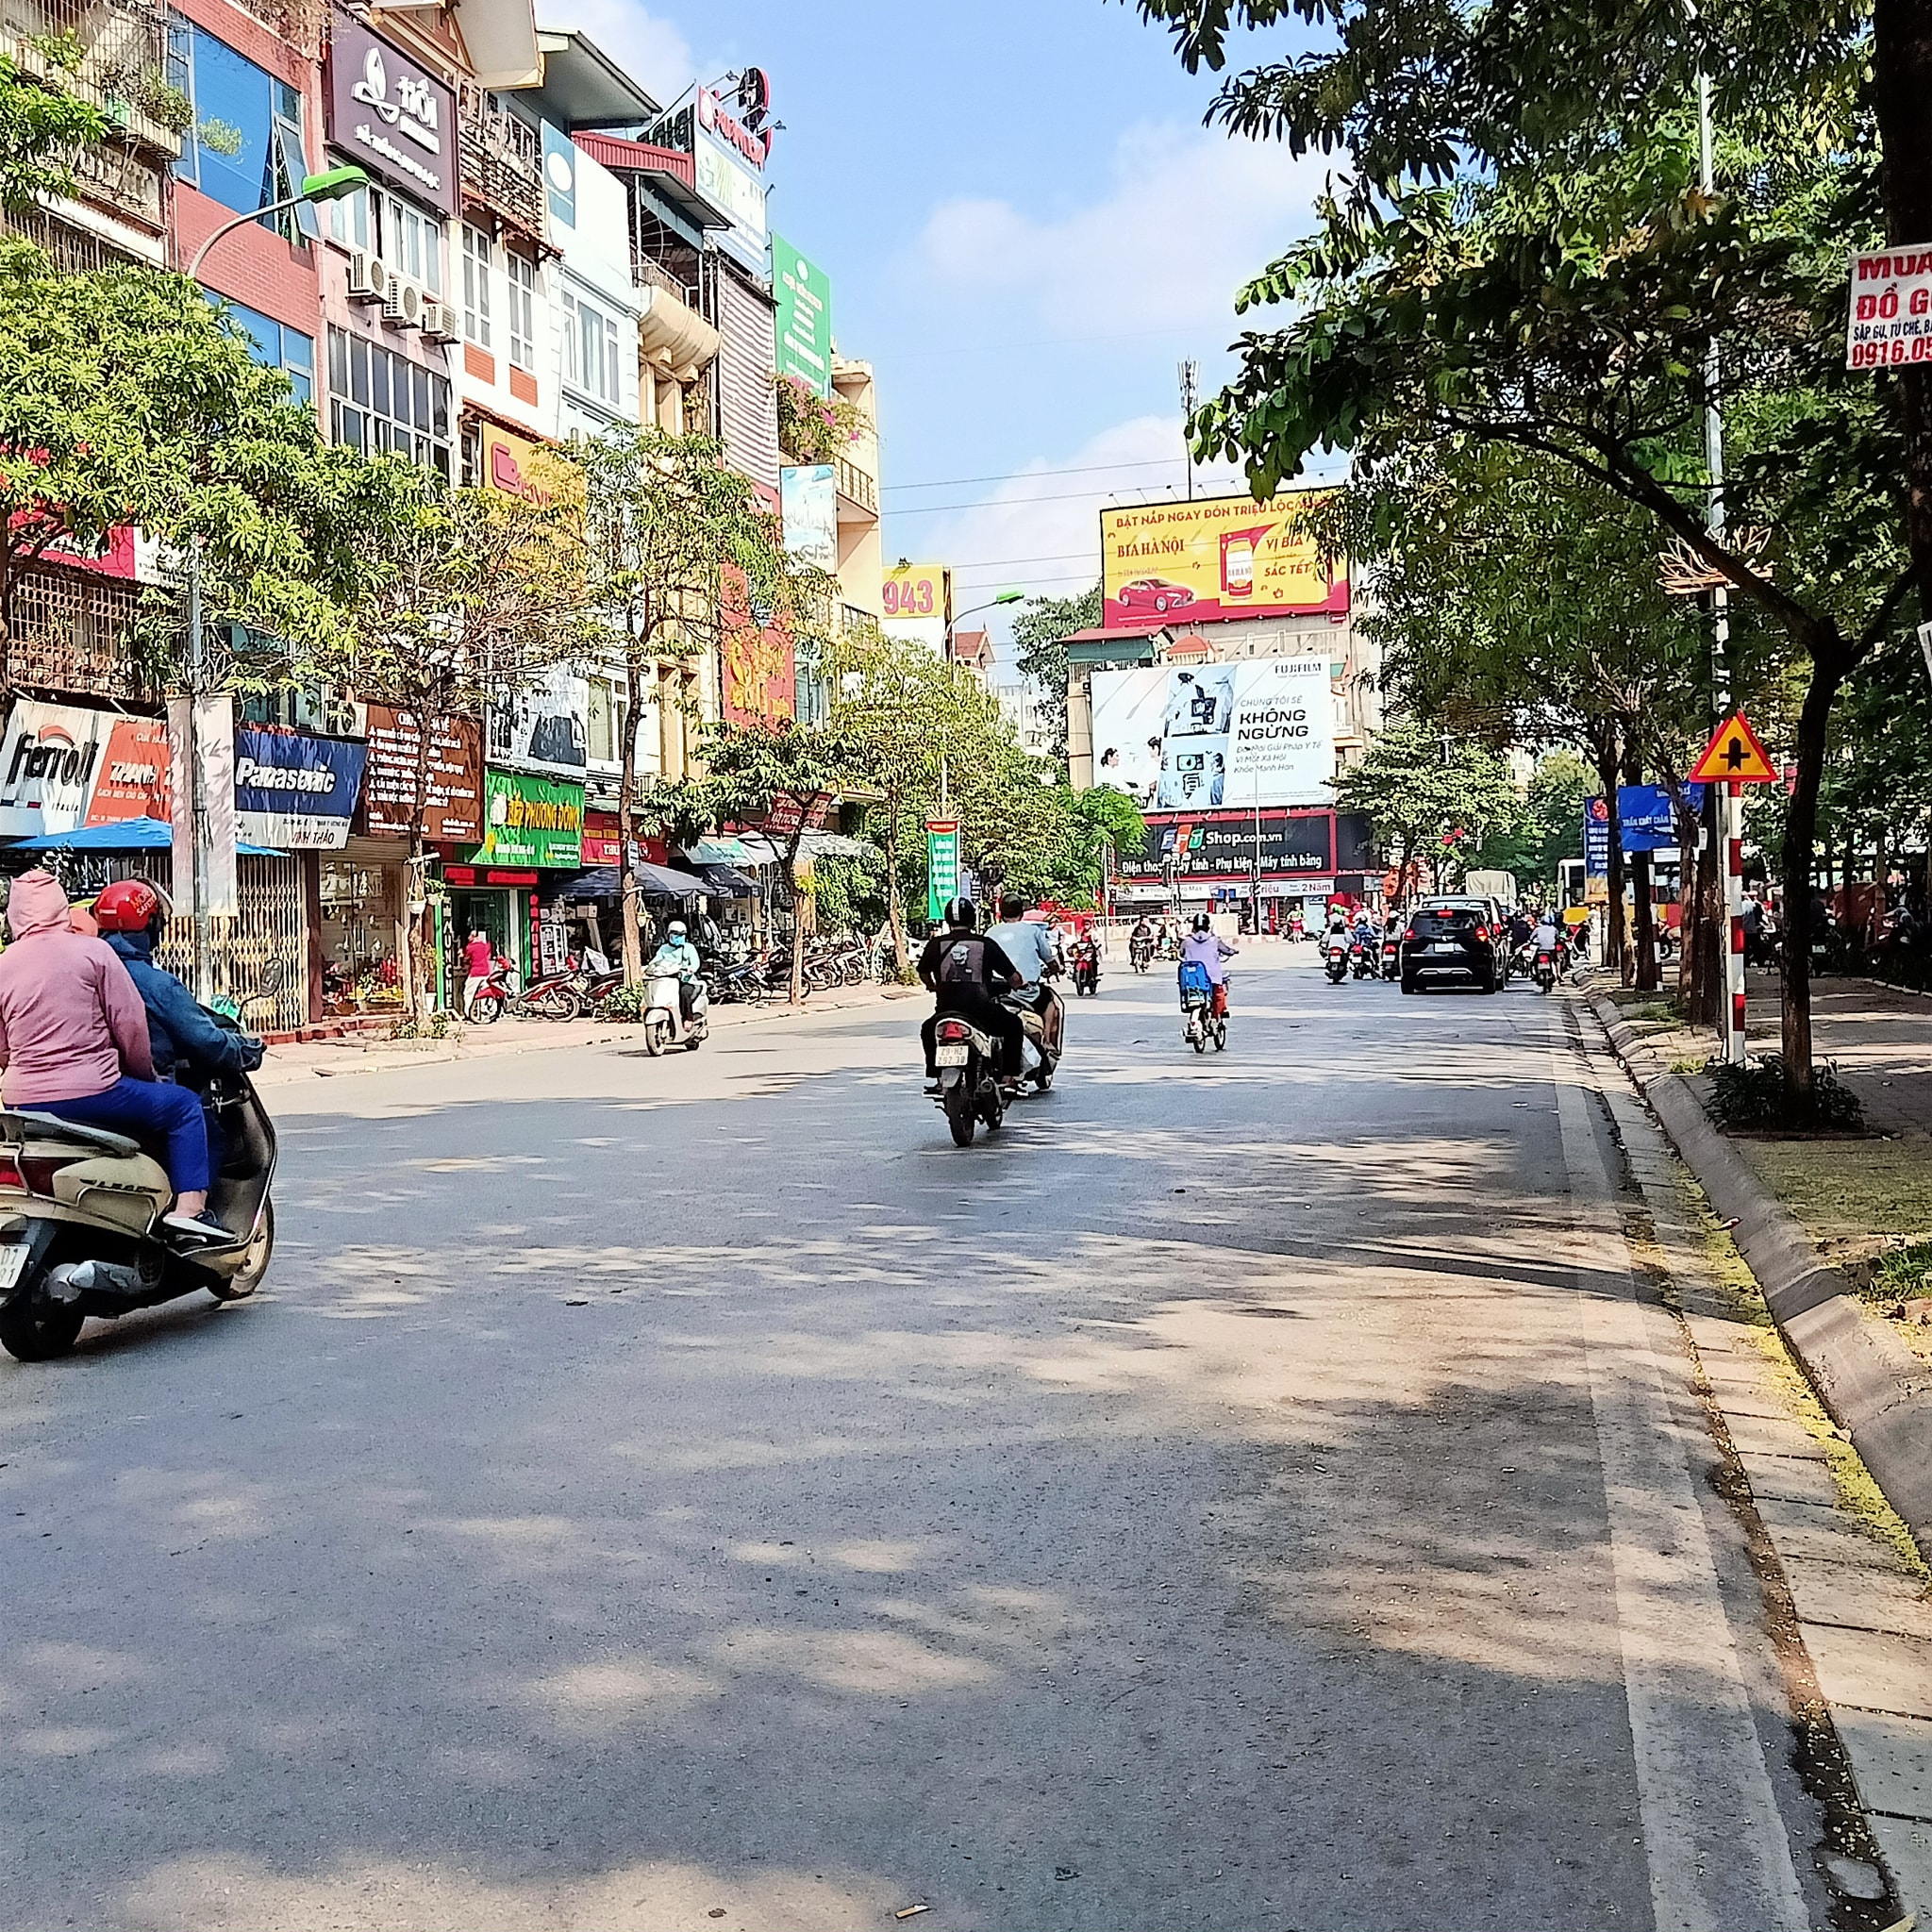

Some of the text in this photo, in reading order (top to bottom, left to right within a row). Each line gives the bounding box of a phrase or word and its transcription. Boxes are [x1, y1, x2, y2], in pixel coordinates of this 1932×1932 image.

[1857, 282, 1932, 321] ĐỒ G
[1117, 514, 1138, 529] BẬT
[1141, 510, 1164, 525] NẮP
[1168, 509, 1201, 523] NGAY
[1205, 504, 1230, 518] ĐÓN
[1117, 536, 1185, 558] BIA HÀ NỘI
[1267, 535, 1303, 552] VỊ BIA
[883, 579, 933, 614] 943
[1275, 663, 1321, 674] FUJIFILM
[1241, 696, 1273, 708] CHÚNG
[1274, 695, 1290, 706] TÔI
[1240, 708, 1307, 724] KHÔNG
[1238, 724, 1308, 741] NGỪNG
[236, 757, 336, 792] Panasonic
[51, 802, 79, 812] ITALIA
[1161, 824, 1205, 854] FPT
[1191, 858, 1209, 871] tính
[1215, 857, 1232, 873] Phụ
[1233, 856, 1253, 873] kiện
[1260, 855, 1278, 870] Máy
[1280, 854, 1297, 867] tính
[1299, 853, 1322, 869] bảng
[1302, 884, 1308, 892] 2
[1309, 883, 1331, 891] Năm
